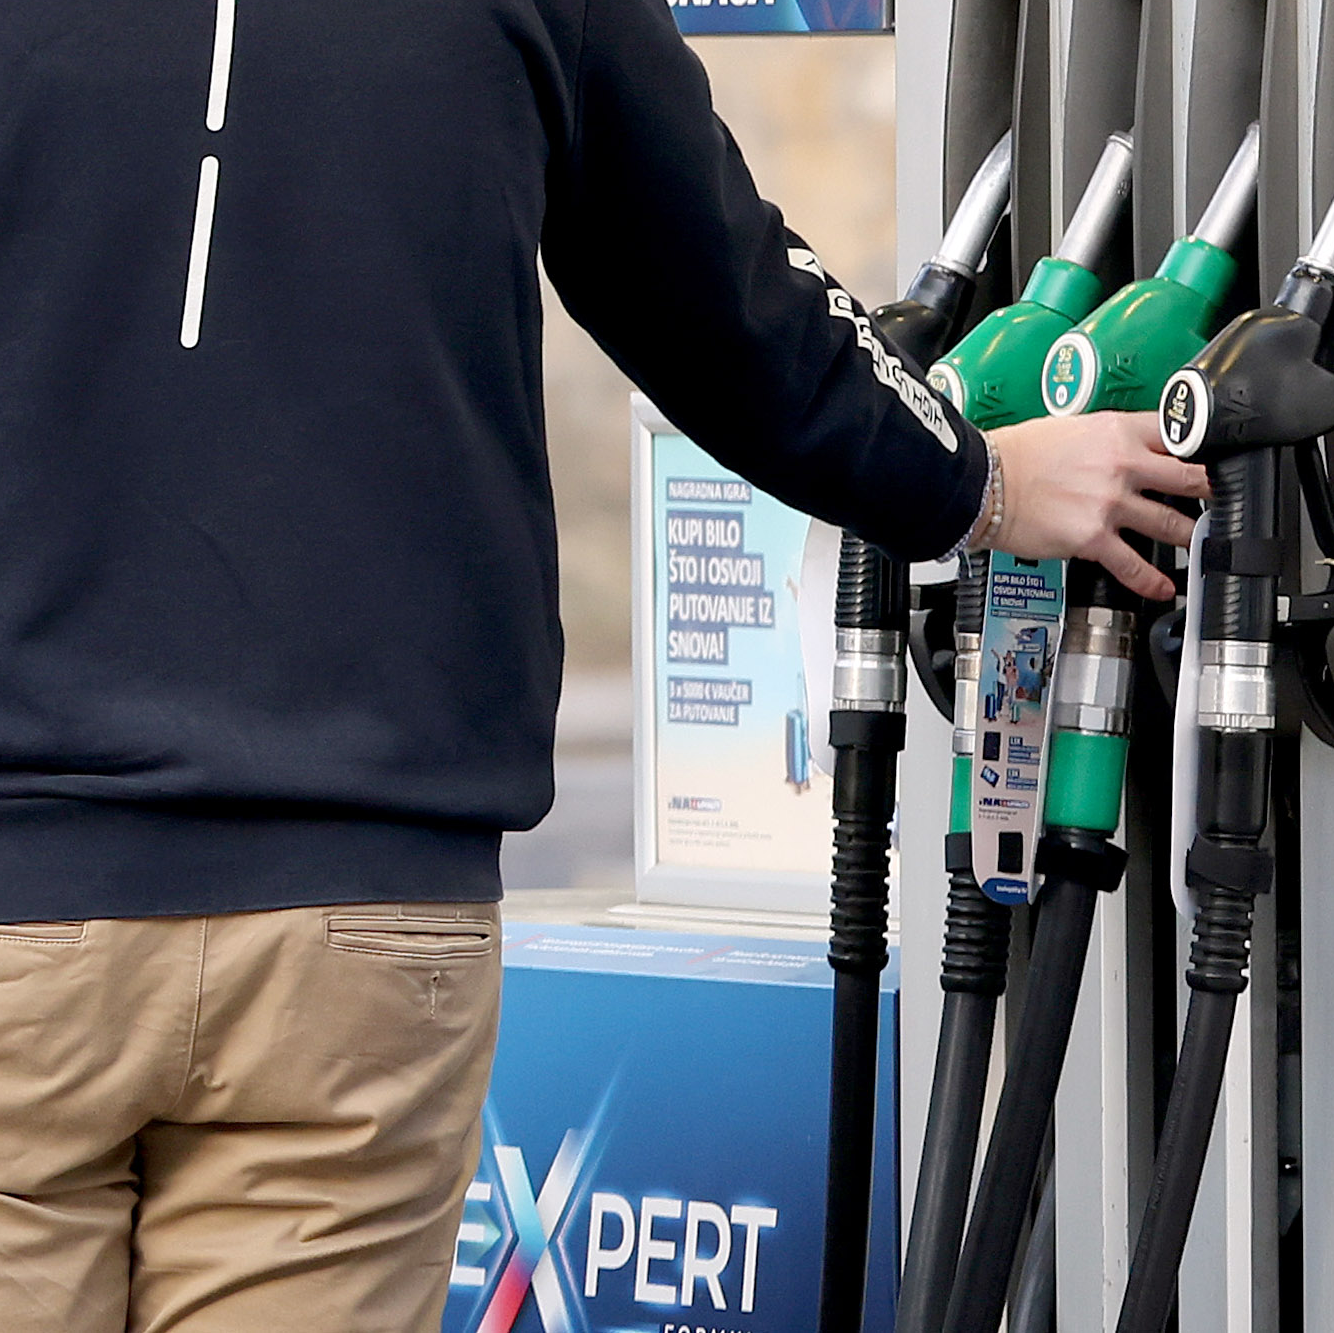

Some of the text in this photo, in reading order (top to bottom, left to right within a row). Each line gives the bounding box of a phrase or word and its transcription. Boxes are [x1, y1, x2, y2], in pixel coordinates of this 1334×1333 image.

[1058, 347, 1073, 363] 95
[1177, 383, 1188, 400] D
[669, 482, 721, 500] NAGRADNA
[669, 518, 739, 548] KUPI BILO
[669, 549, 761, 586] ŠTO I OSVOJI
[670, 594, 772, 624] PUTOVANJE IZ
[669, 631, 724, 660] SNOVA!
[669, 702, 735, 722] ZA PUTOVANJE
